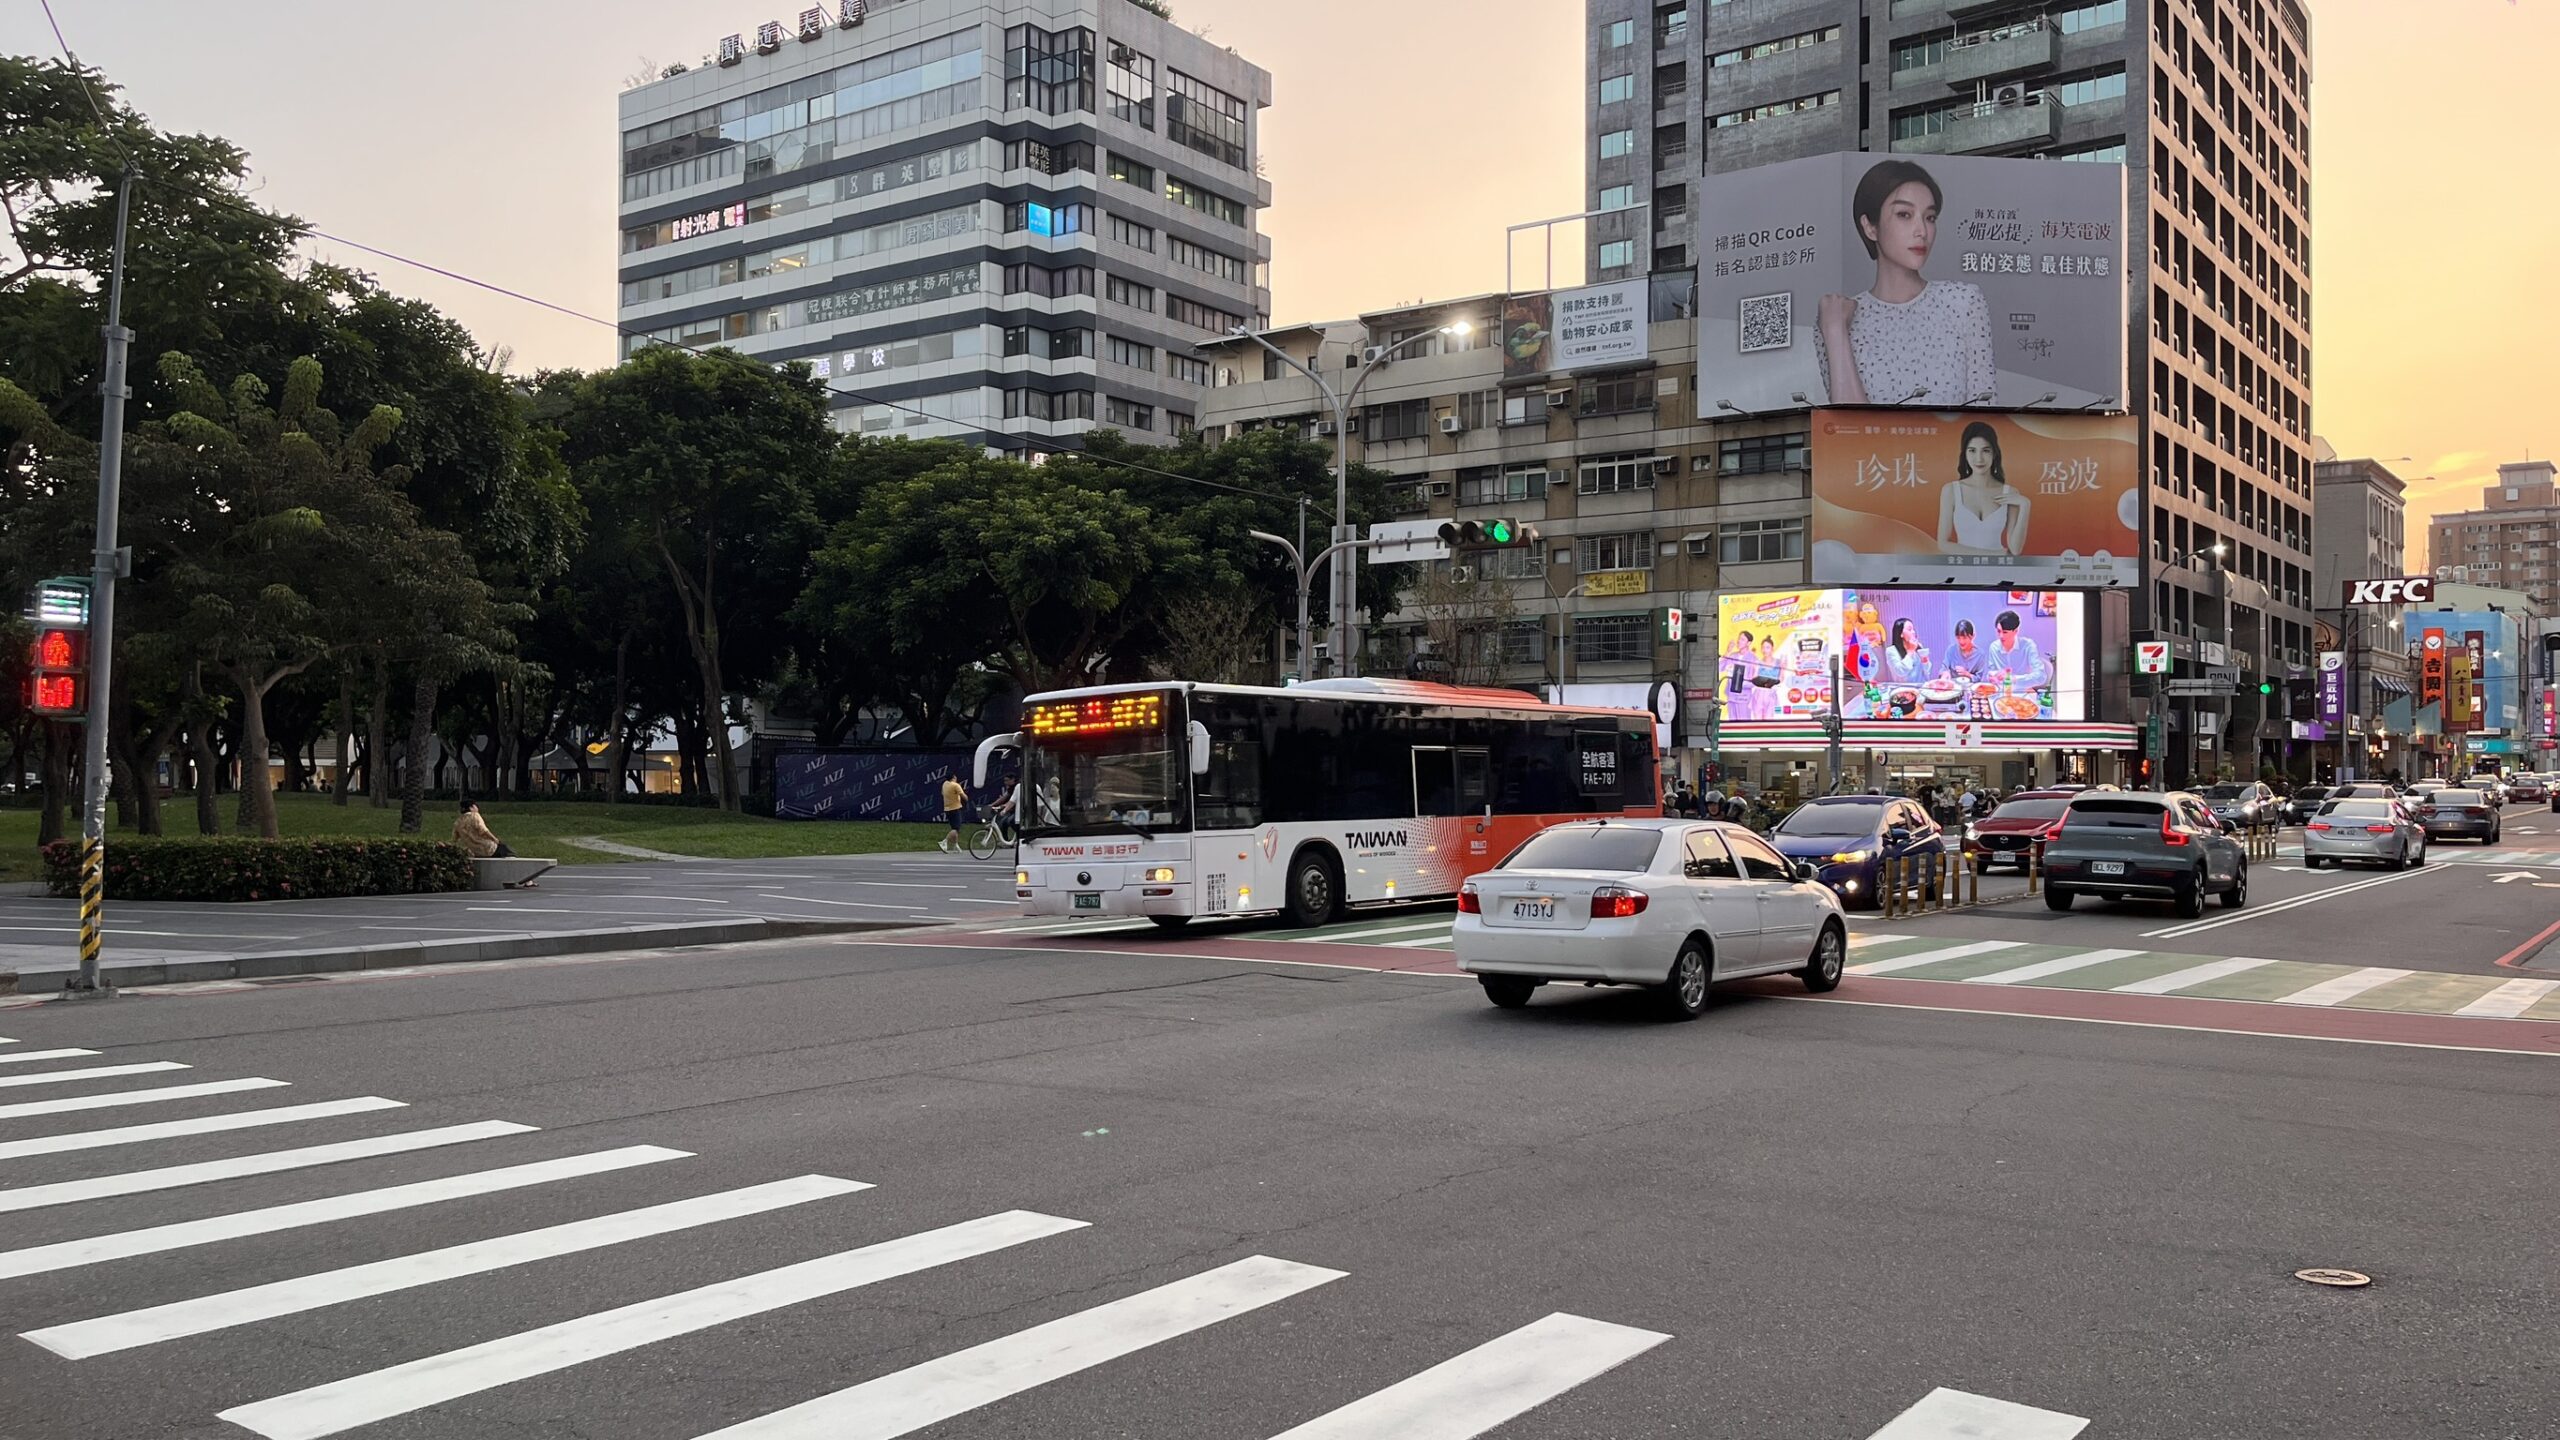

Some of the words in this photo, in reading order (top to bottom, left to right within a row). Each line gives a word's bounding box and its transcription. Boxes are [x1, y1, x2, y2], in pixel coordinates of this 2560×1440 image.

[1775, 223, 1815, 241] Code
[2041, 221, 2113, 241] 海芙電波
[1715, 247, 1816, 277] 指名認證診所
[1962, 253, 2032, 274] 我的姿態
[2041, 255, 2110, 277] 最佳狀態
[1562, 295, 1609, 313] 捐款支持
[1562, 320, 1633, 340] 動物安心成家
[1855, 453, 1928, 493] 珍珠
[2038, 457, 2102, 495] 盈波
[2350, 579, 2429, 603] KFC
[805, 754, 827, 773] JAZZ
[1582, 751, 1616, 768] 全航客運
[872, 766, 895, 786] JAZZ
[1583, 773, 1616, 785] FAE-787
[860, 795, 882, 815] JAZZ
[1345, 831, 1408, 849] TAIWAN
[1042, 846, 1084, 855] TAIWAN
